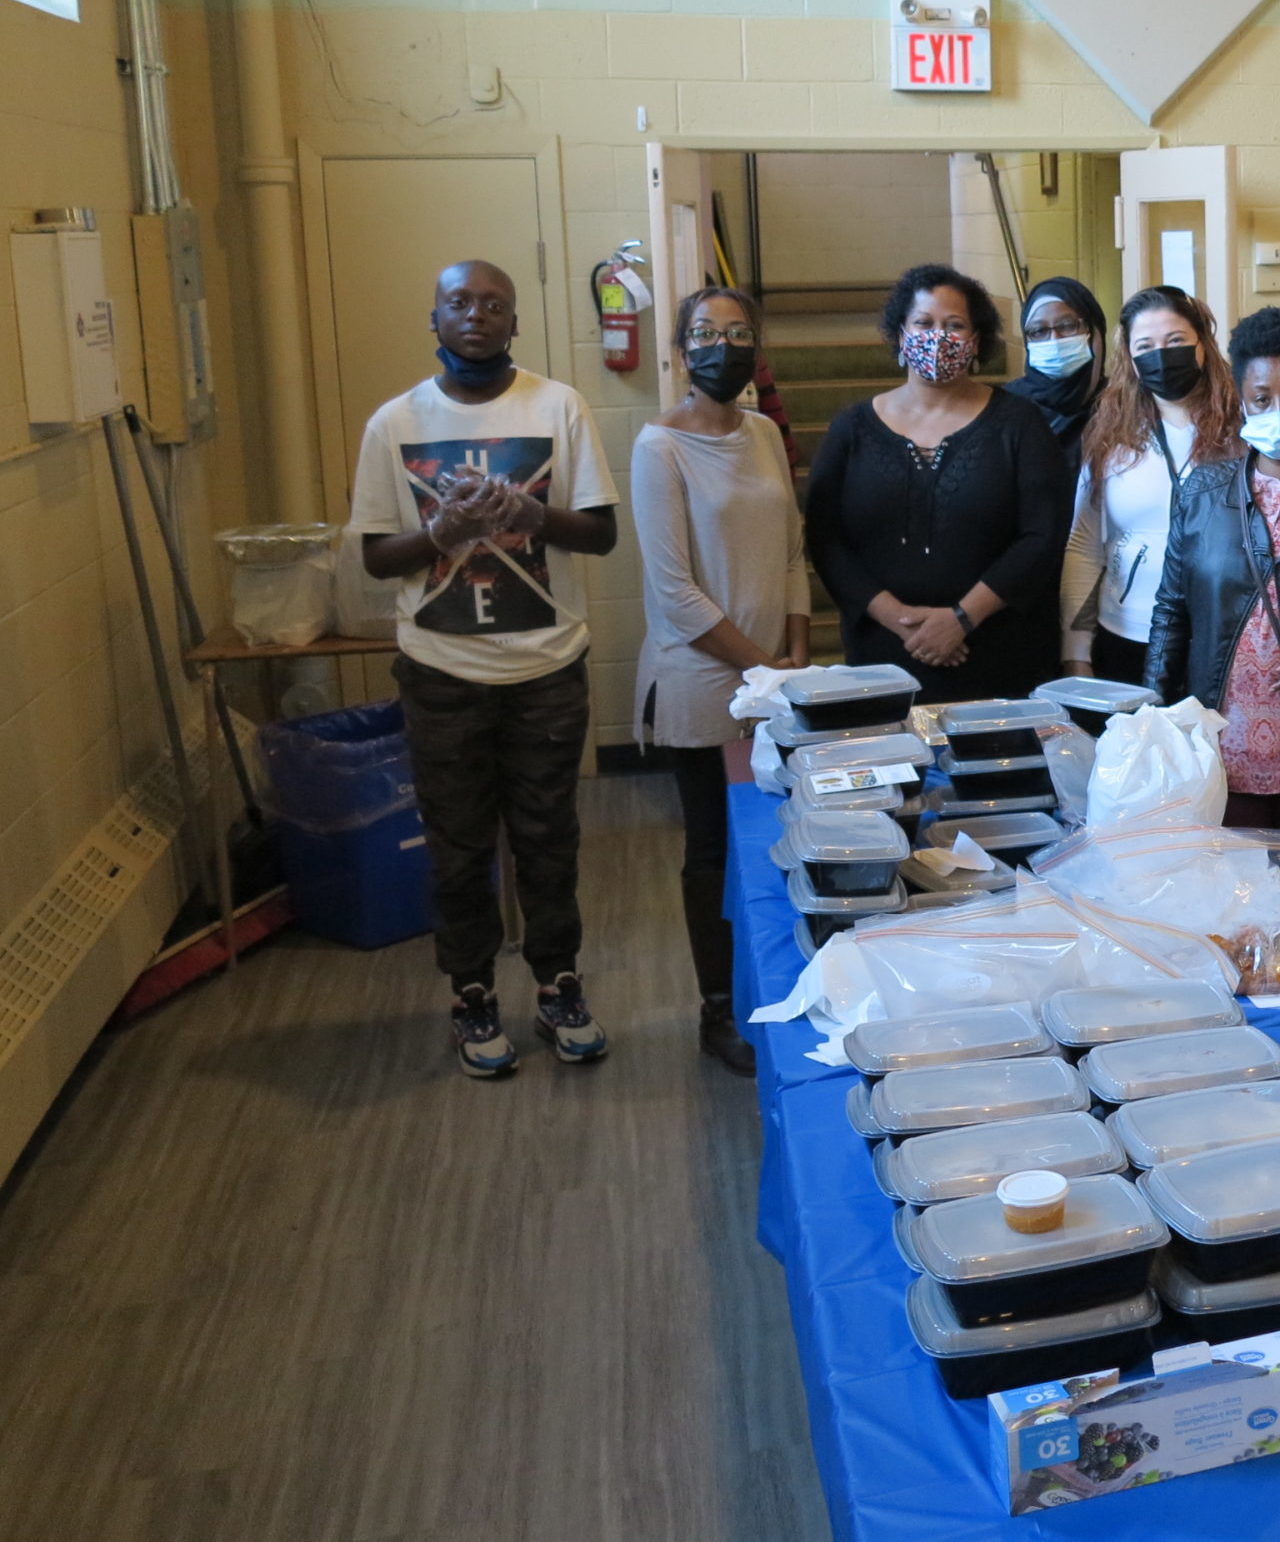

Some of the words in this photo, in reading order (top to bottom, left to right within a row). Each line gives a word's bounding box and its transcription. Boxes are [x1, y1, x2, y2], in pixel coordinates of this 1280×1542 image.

[909, 33, 974, 84] EXIT
[474, 582, 495, 624] E
[1025, 1389, 1060, 1404] 30
[1038, 1435, 1072, 1459] 30
